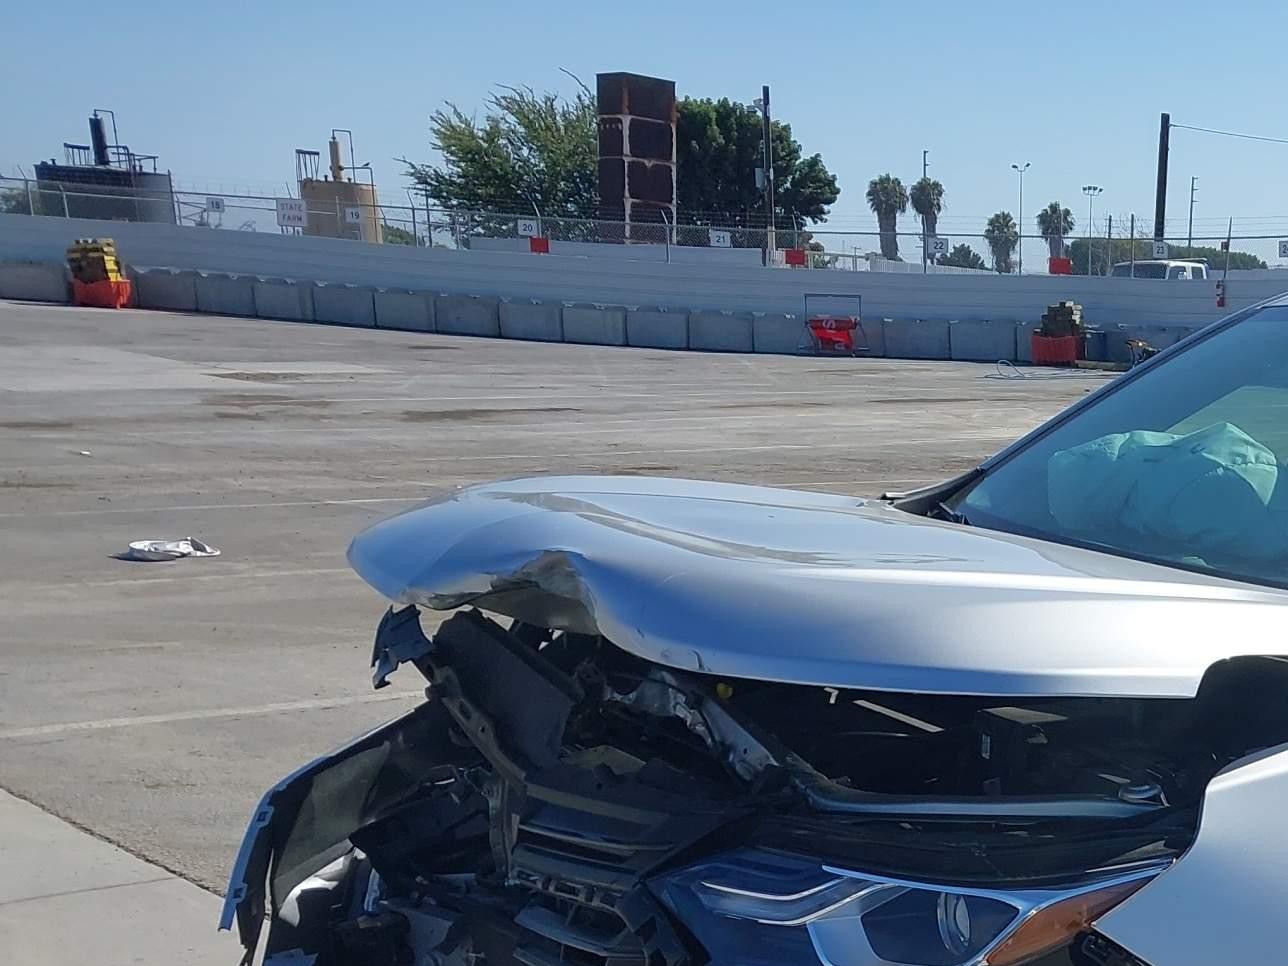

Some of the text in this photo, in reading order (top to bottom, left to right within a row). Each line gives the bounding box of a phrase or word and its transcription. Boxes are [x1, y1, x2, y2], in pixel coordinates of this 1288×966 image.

[280, 203, 303, 212] STATE
[282, 214, 302, 222] FARM
[350, 211, 360, 220] 19
[522, 224, 533, 232] 20
[716, 235, 726, 243] 21
[933, 242, 944, 250] 22
